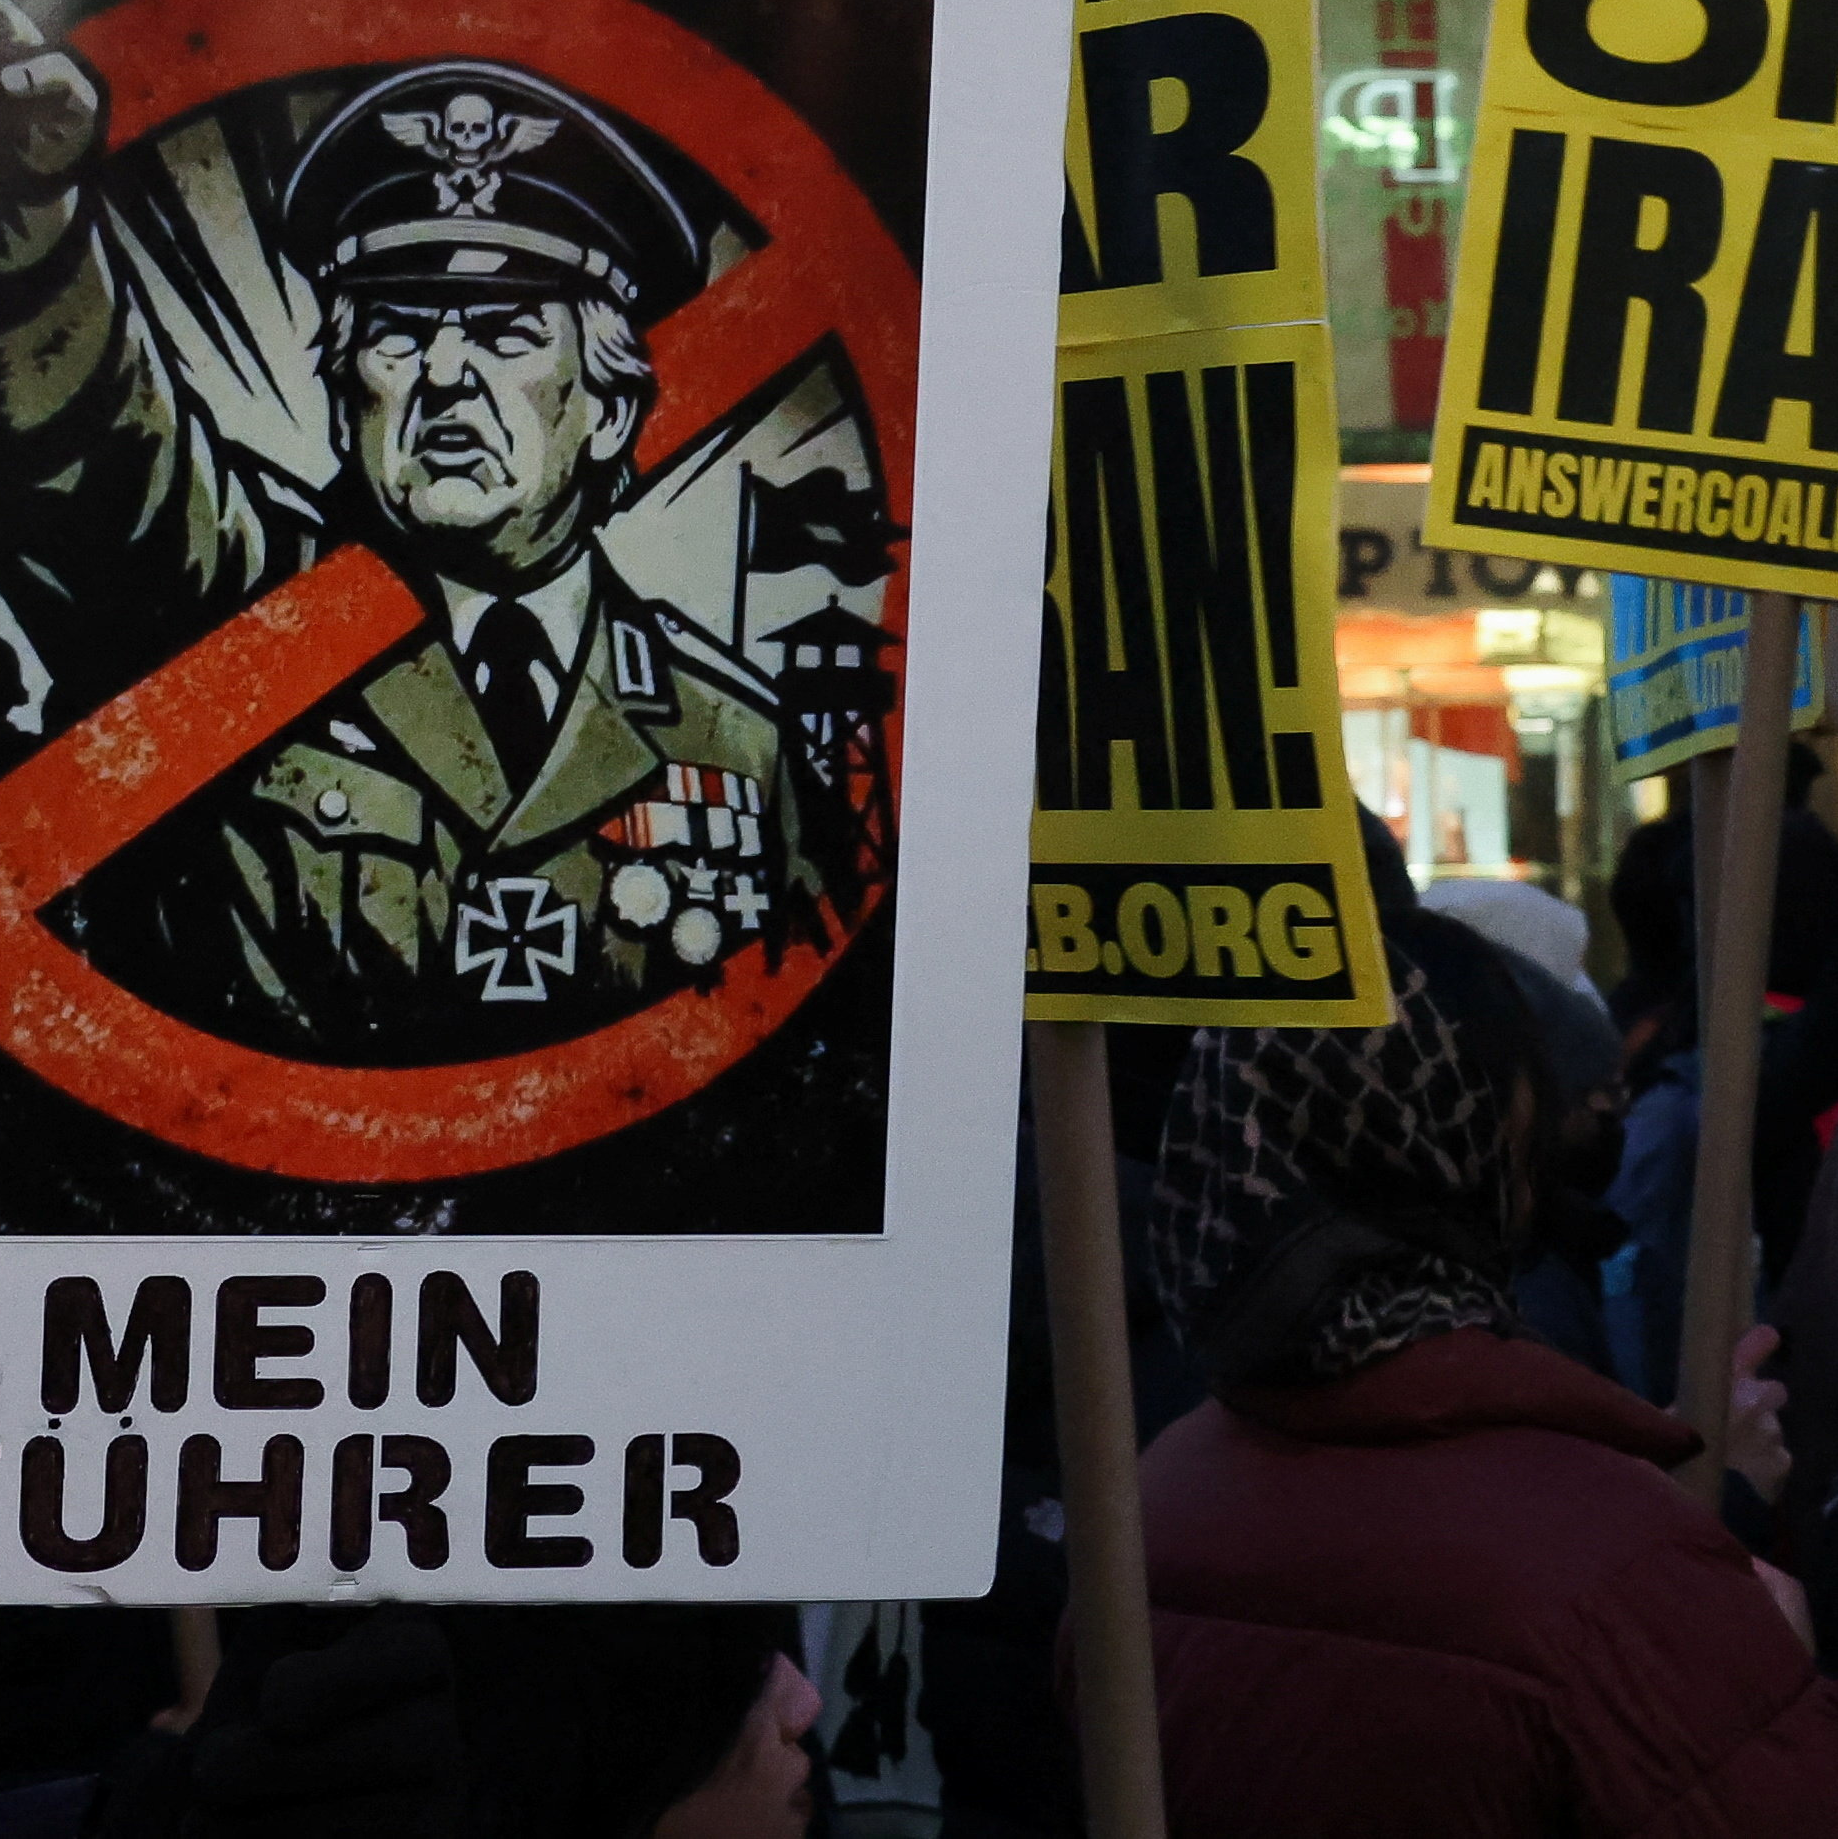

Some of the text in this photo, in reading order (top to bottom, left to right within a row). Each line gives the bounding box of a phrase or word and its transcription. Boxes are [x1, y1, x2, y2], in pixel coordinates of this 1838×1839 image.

[1038, 362, 1324, 808] AN!
[1027, 881, 1342, 982] B.ORG
[40, 1266, 542, 1416] MEIN
